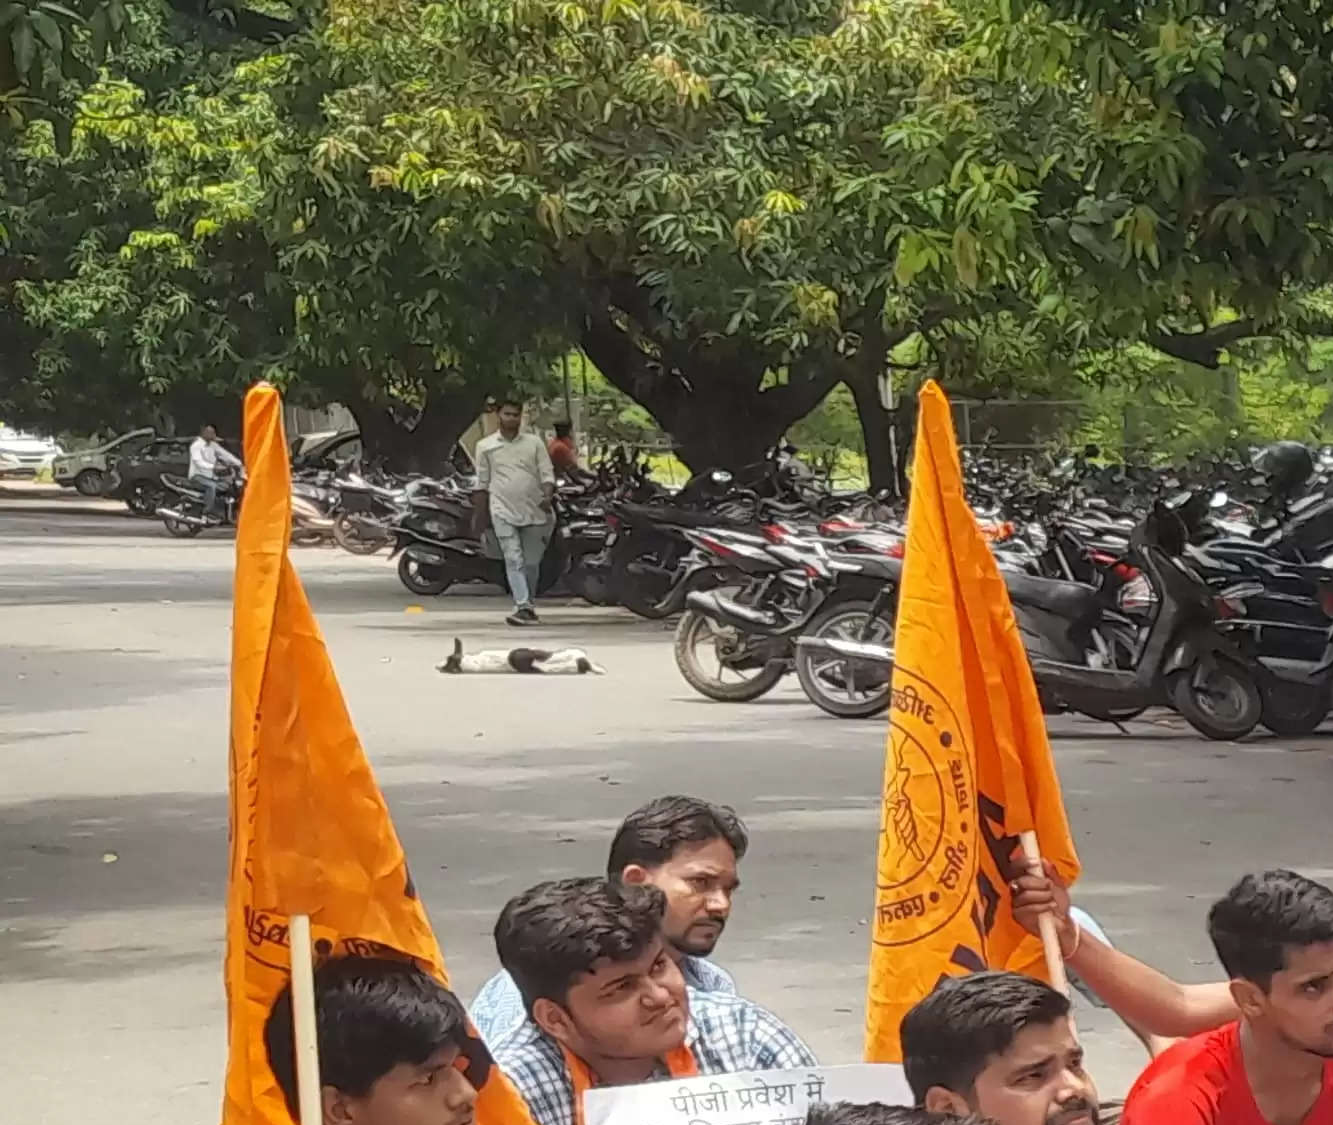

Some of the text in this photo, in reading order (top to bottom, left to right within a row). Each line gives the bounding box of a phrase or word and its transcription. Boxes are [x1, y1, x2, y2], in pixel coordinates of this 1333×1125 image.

[669, 1074, 825, 1117] पीजी प्रवेश में
